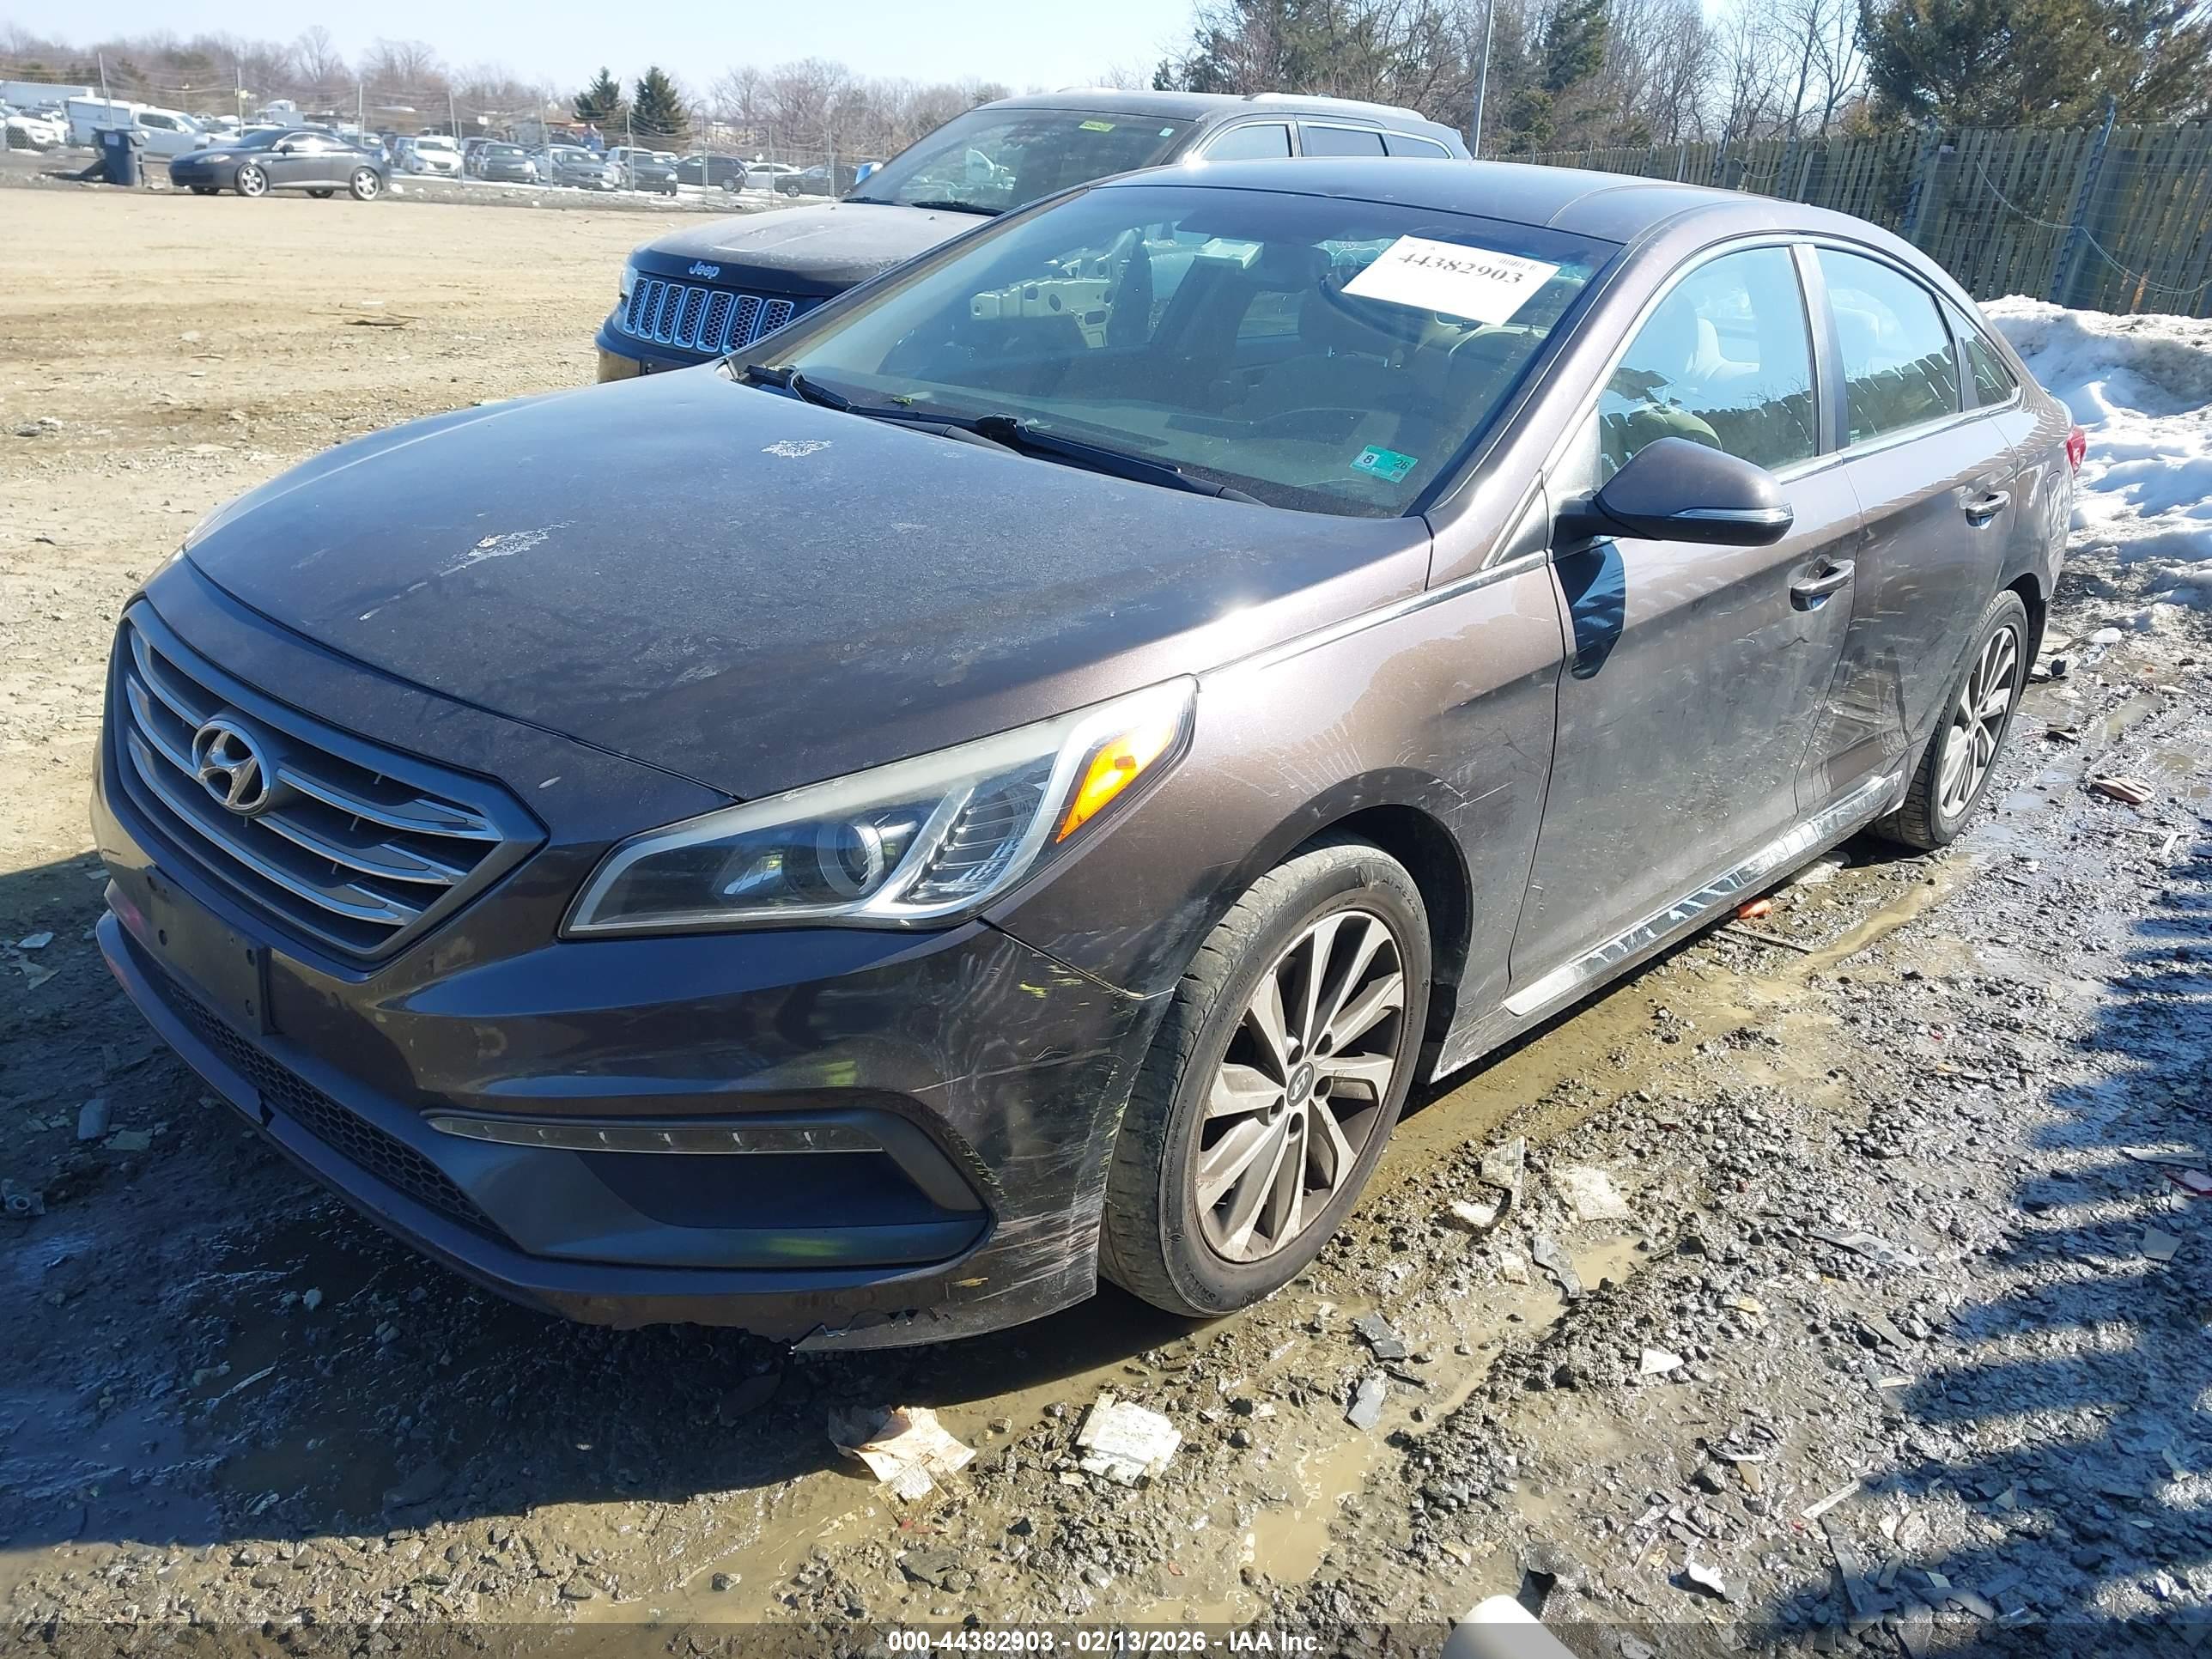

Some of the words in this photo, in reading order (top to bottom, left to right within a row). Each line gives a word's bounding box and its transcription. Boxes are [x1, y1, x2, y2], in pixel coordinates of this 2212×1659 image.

[688, 260, 720, 280] Jeep
[1398, 253, 1524, 283] 44382903
[1363, 454, 1375, 464] 8
